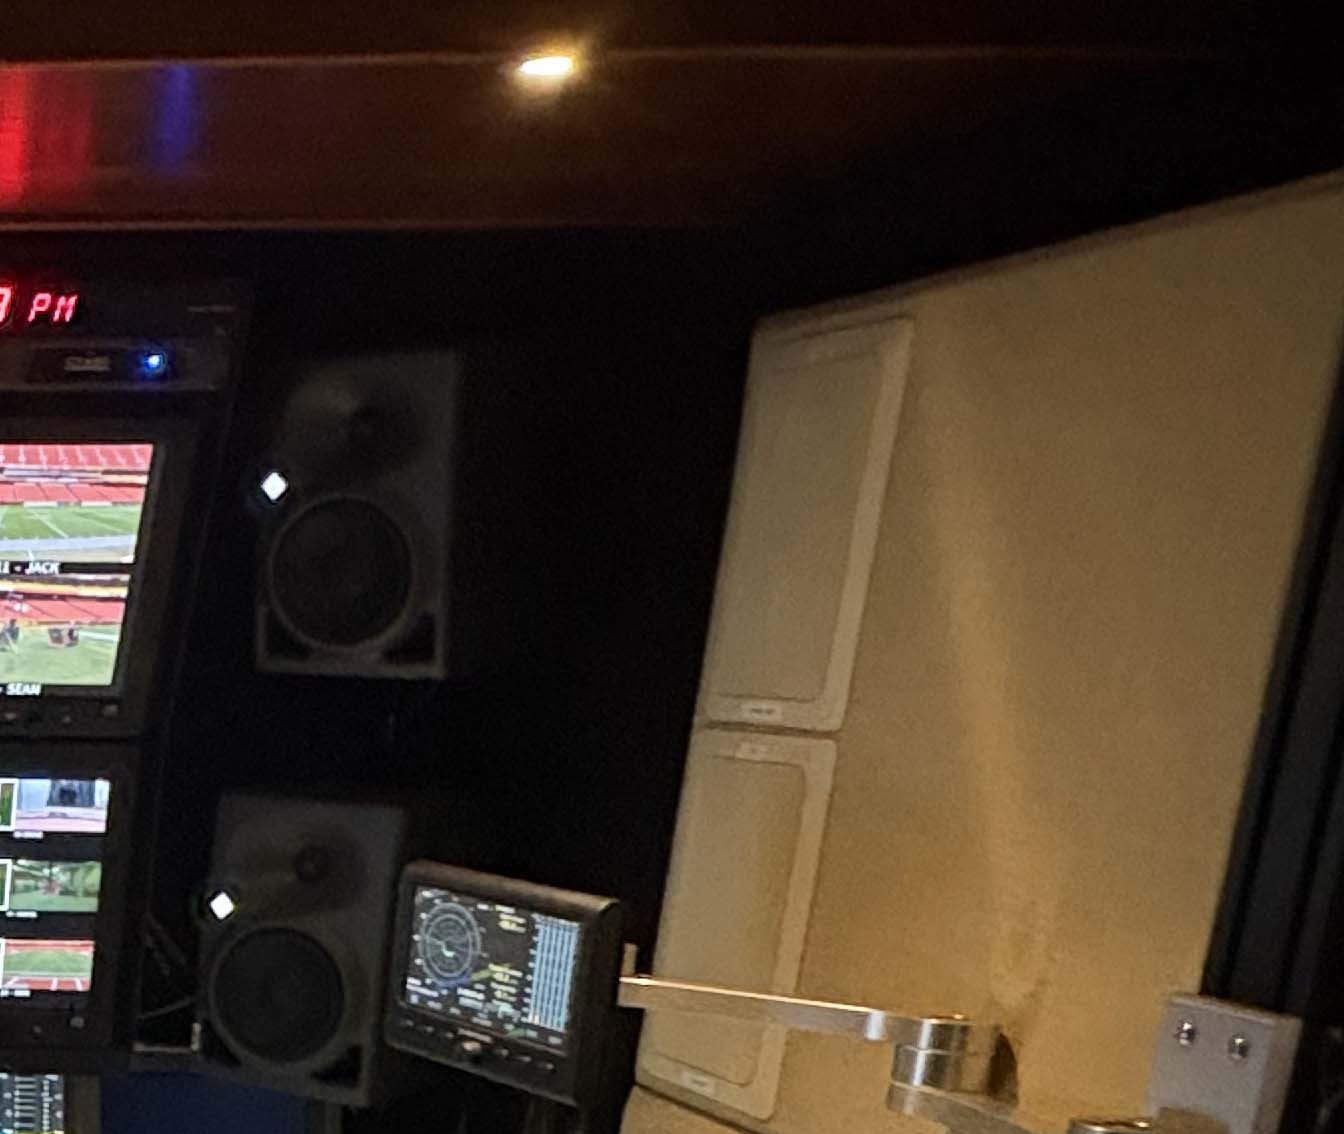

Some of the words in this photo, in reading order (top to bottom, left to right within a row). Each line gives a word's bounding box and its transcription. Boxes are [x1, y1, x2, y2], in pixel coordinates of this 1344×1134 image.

[26, 293, 79, 323] PM
[23, 561, 61, 576] JACK
[5, 684, 43, 697] SEAN
